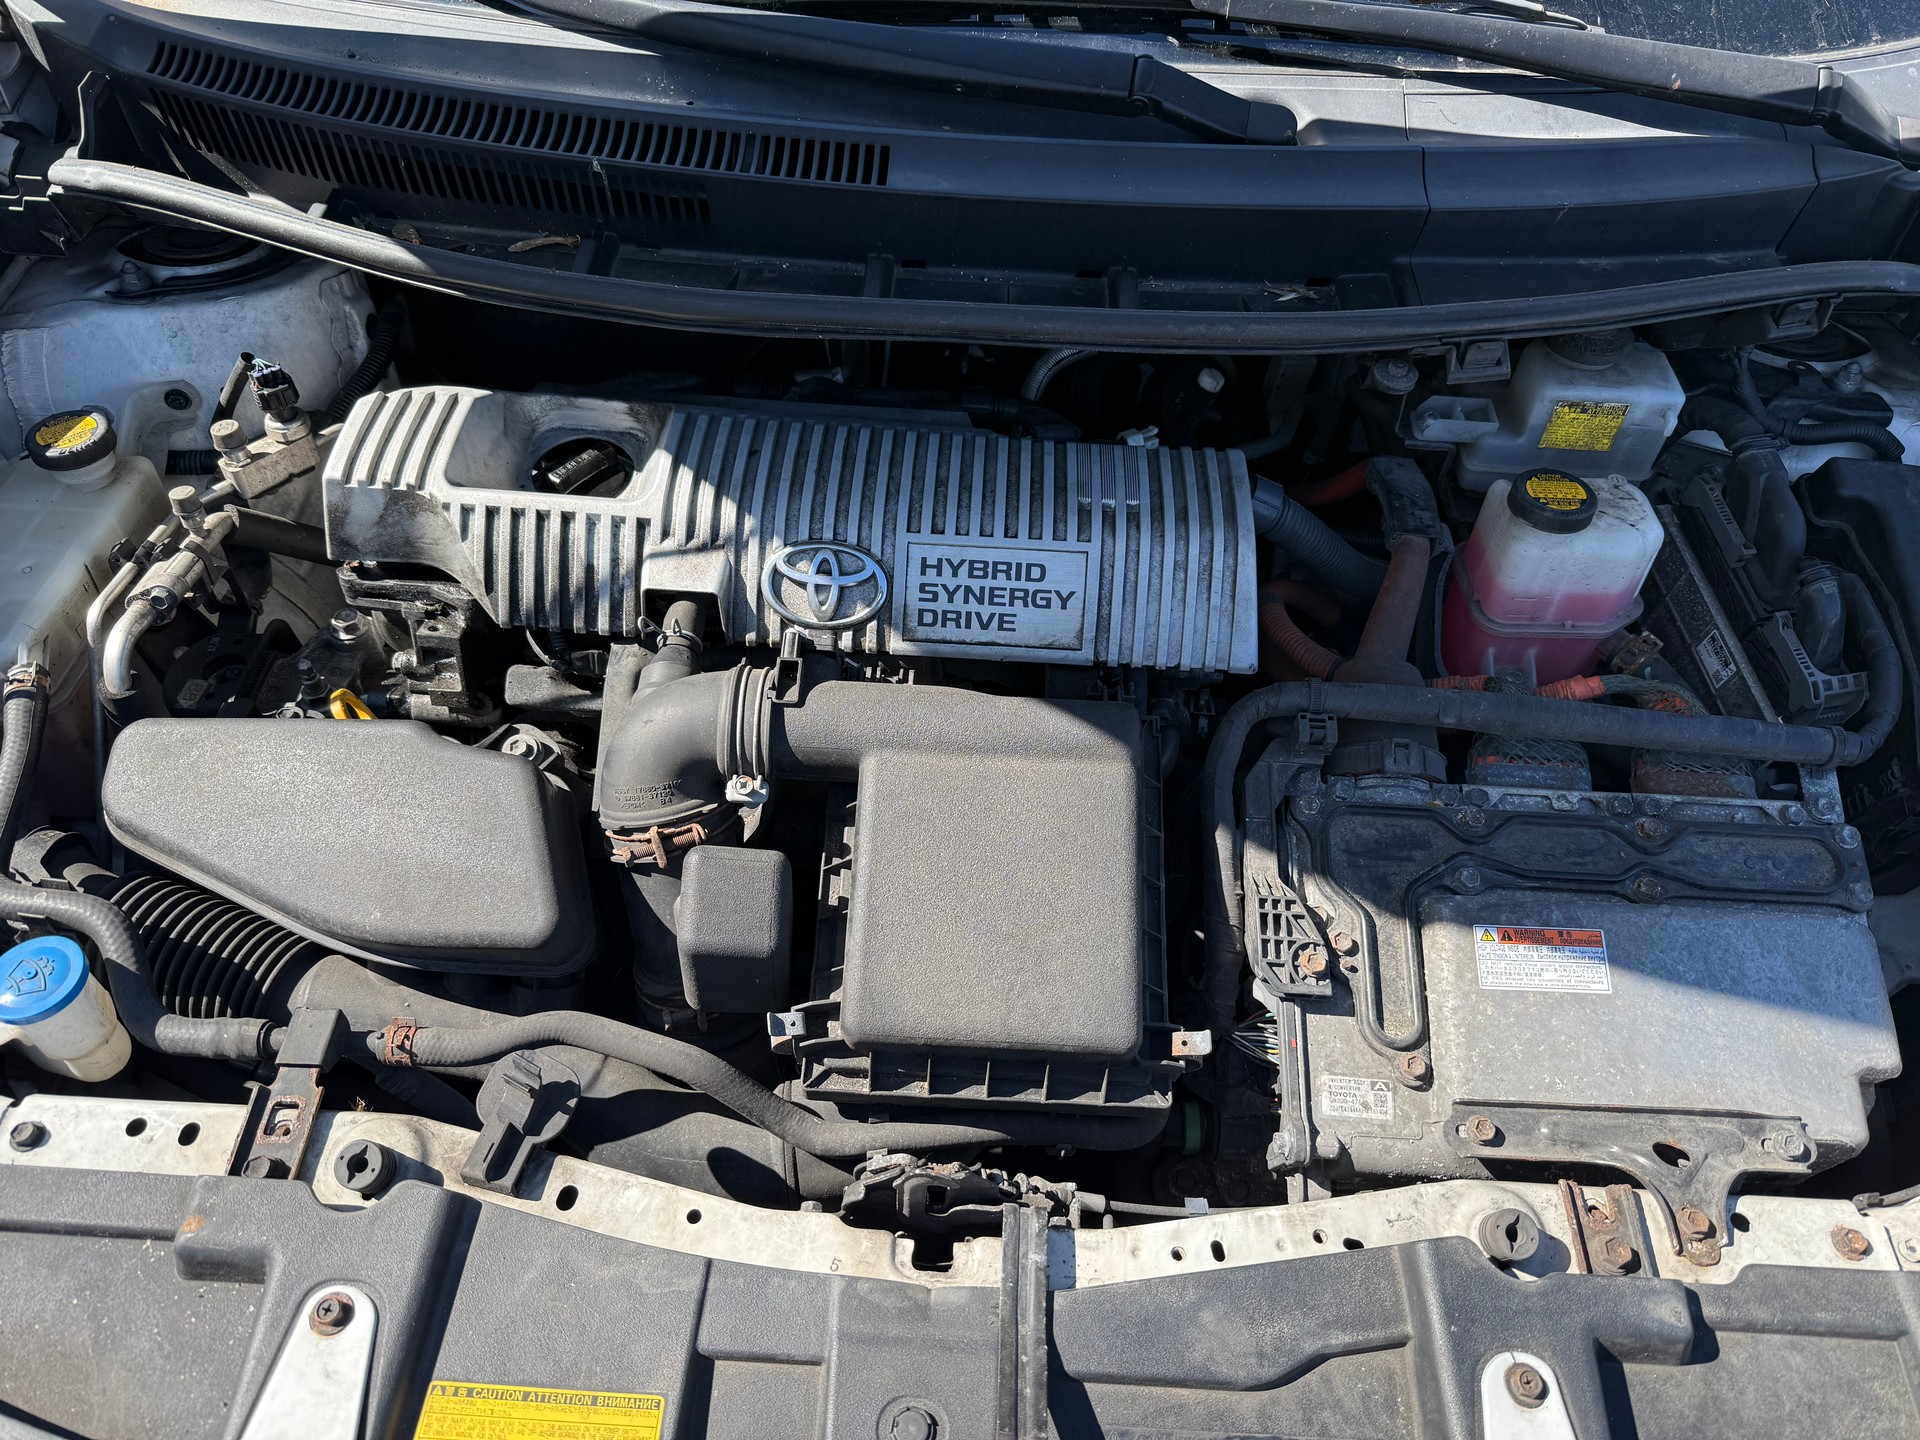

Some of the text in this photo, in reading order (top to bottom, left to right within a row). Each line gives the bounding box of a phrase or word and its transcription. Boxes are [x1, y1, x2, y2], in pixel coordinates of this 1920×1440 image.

[920, 557, 1046, 583] HYBRID
[918, 583, 1076, 610] SYNERGY
[917, 608, 1017, 632] DRIVE
[1513, 929, 1545, 937] WARNING
[1514, 936, 1554, 944] AVERTISSEMENT
[830, 1256, 842, 1272] 5
[473, 1388, 592, 1406] CAUTION ATTENTION
[597, 1396, 659, 1410] ВНИМАНИЕ
